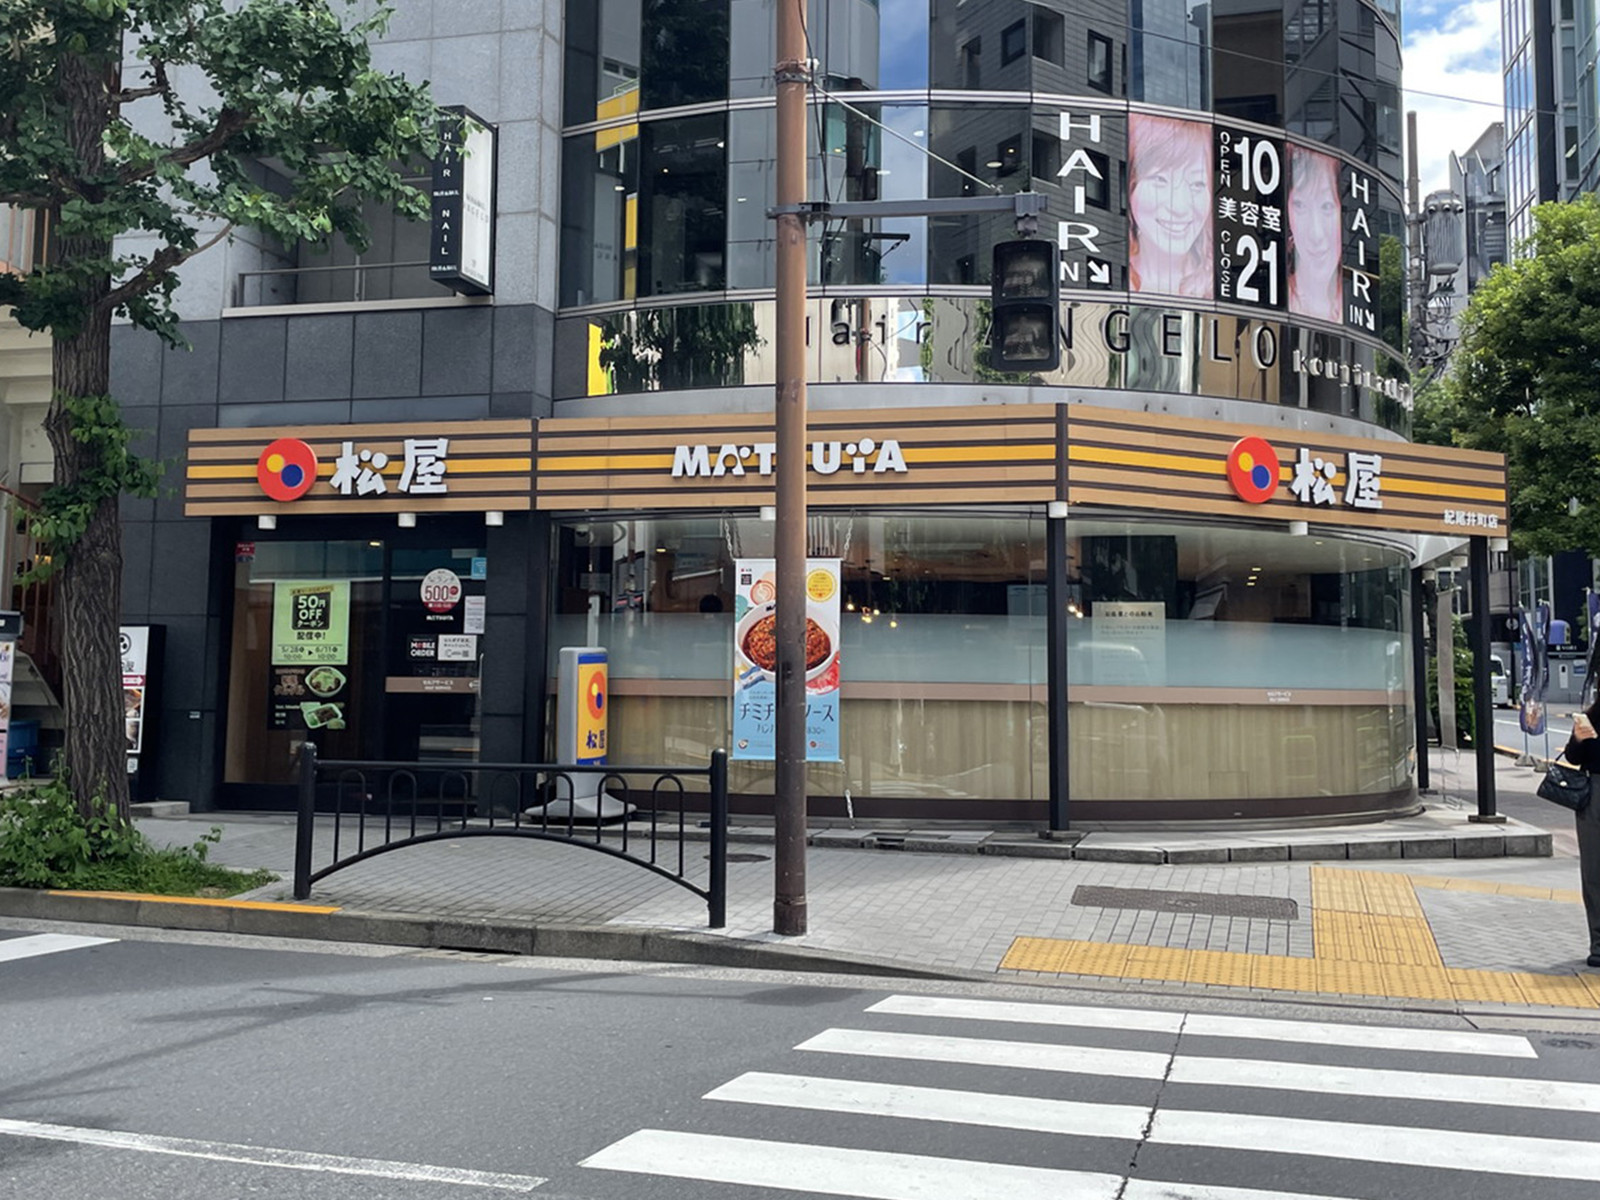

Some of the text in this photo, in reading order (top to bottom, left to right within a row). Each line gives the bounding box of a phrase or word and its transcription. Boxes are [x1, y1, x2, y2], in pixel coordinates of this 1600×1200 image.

[443, 132, 451, 177] HAIR
[1220, 131, 1231, 188] OPEN
[1234, 136, 1280, 195] 10
[1057, 112, 1103, 253] HAIR
[441, 209, 450, 255] NAIL
[1218, 197, 1281, 232] 美容室
[1351, 172, 1371, 303] HAIR
[1060, 261, 1079, 281] N
[1221, 230, 1231, 297] CLOSE
[1236, 234, 1278, 305] 21
[985, 306, 1277, 369] NGELO
[1350, 304, 1363, 326] IN
[329, 437, 449, 496] 松屋
[671, 438, 908, 477] MATUYA
[1291, 447, 1383, 509] 松屋
[1444, 509, 1498, 529] 紀尾井町店
[299, 609, 322, 620] OFF
[425, 585, 448, 601] 500
[410, 649, 435, 657] ORDER
